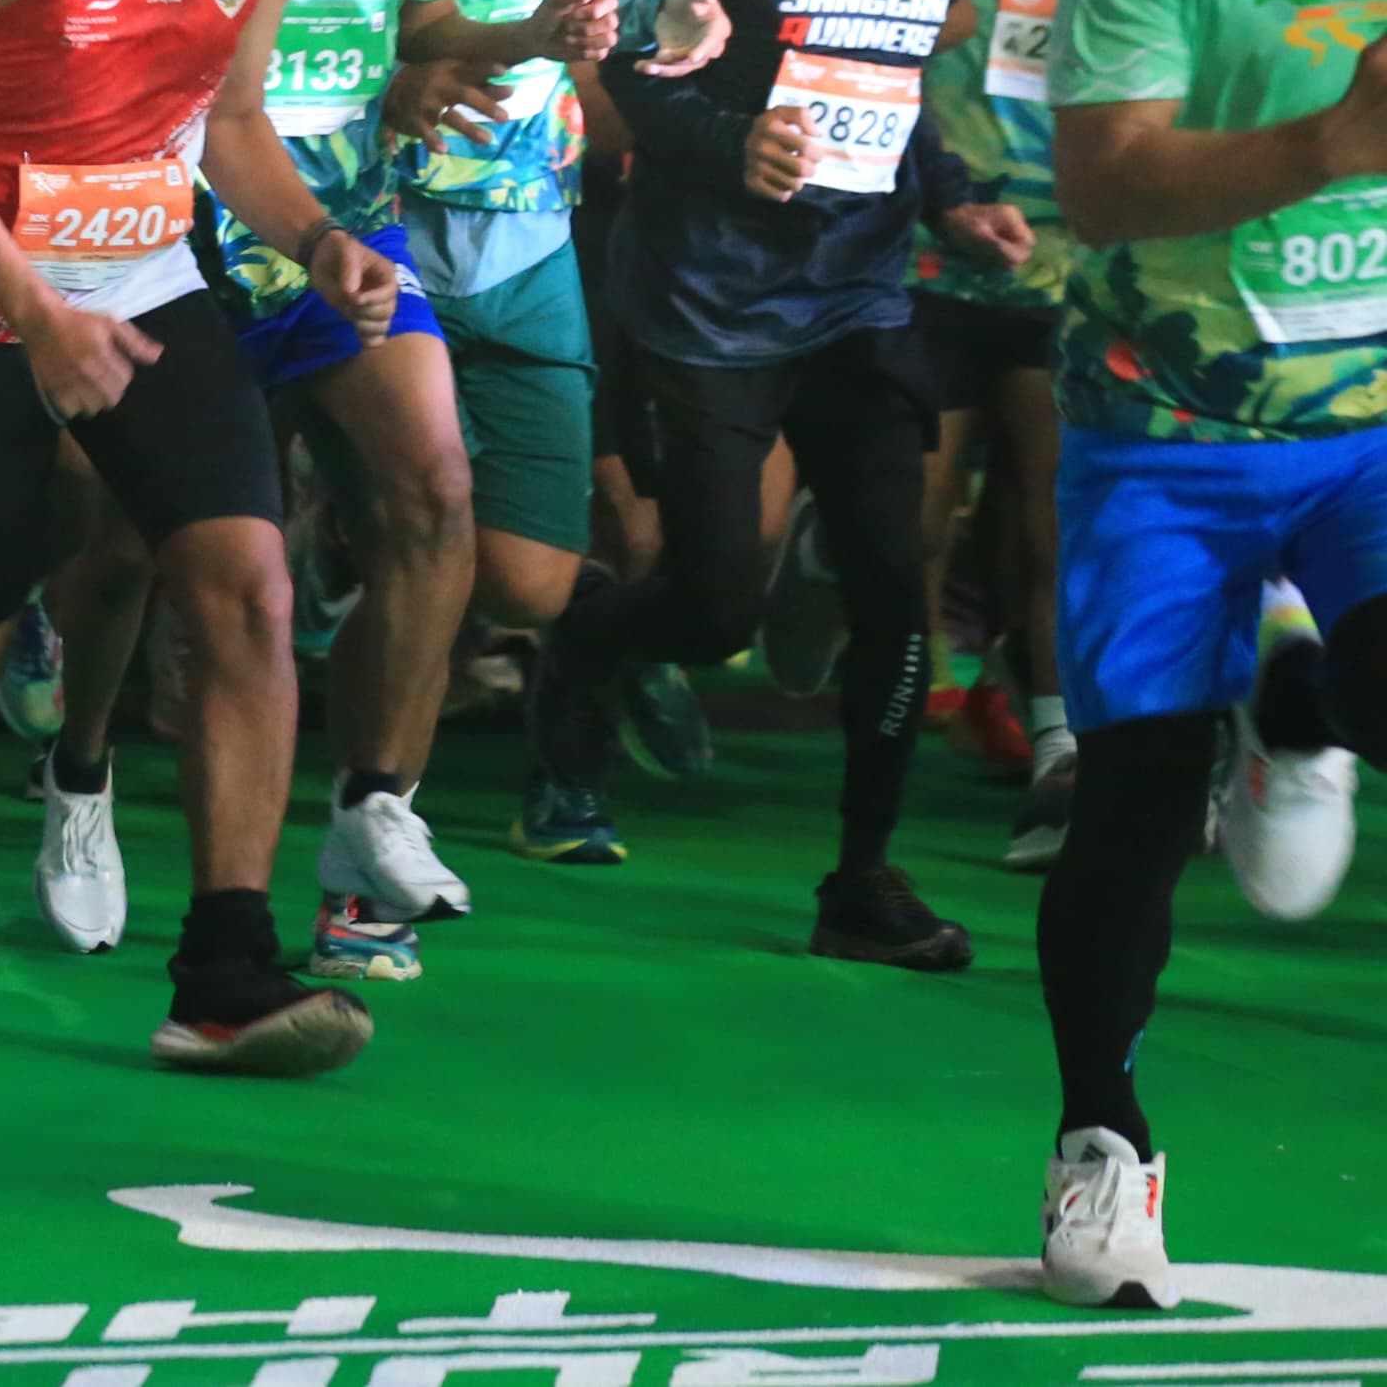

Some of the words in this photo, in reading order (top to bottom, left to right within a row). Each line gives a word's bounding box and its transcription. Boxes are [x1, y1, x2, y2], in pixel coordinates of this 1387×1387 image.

[778, 16, 940, 57] RUNNERS
[809, 101, 899, 148] 2828
[49, 204, 167, 248] 2420
[1282, 228, 1387, 287] 802
[879, 684, 915, 737] RUN
